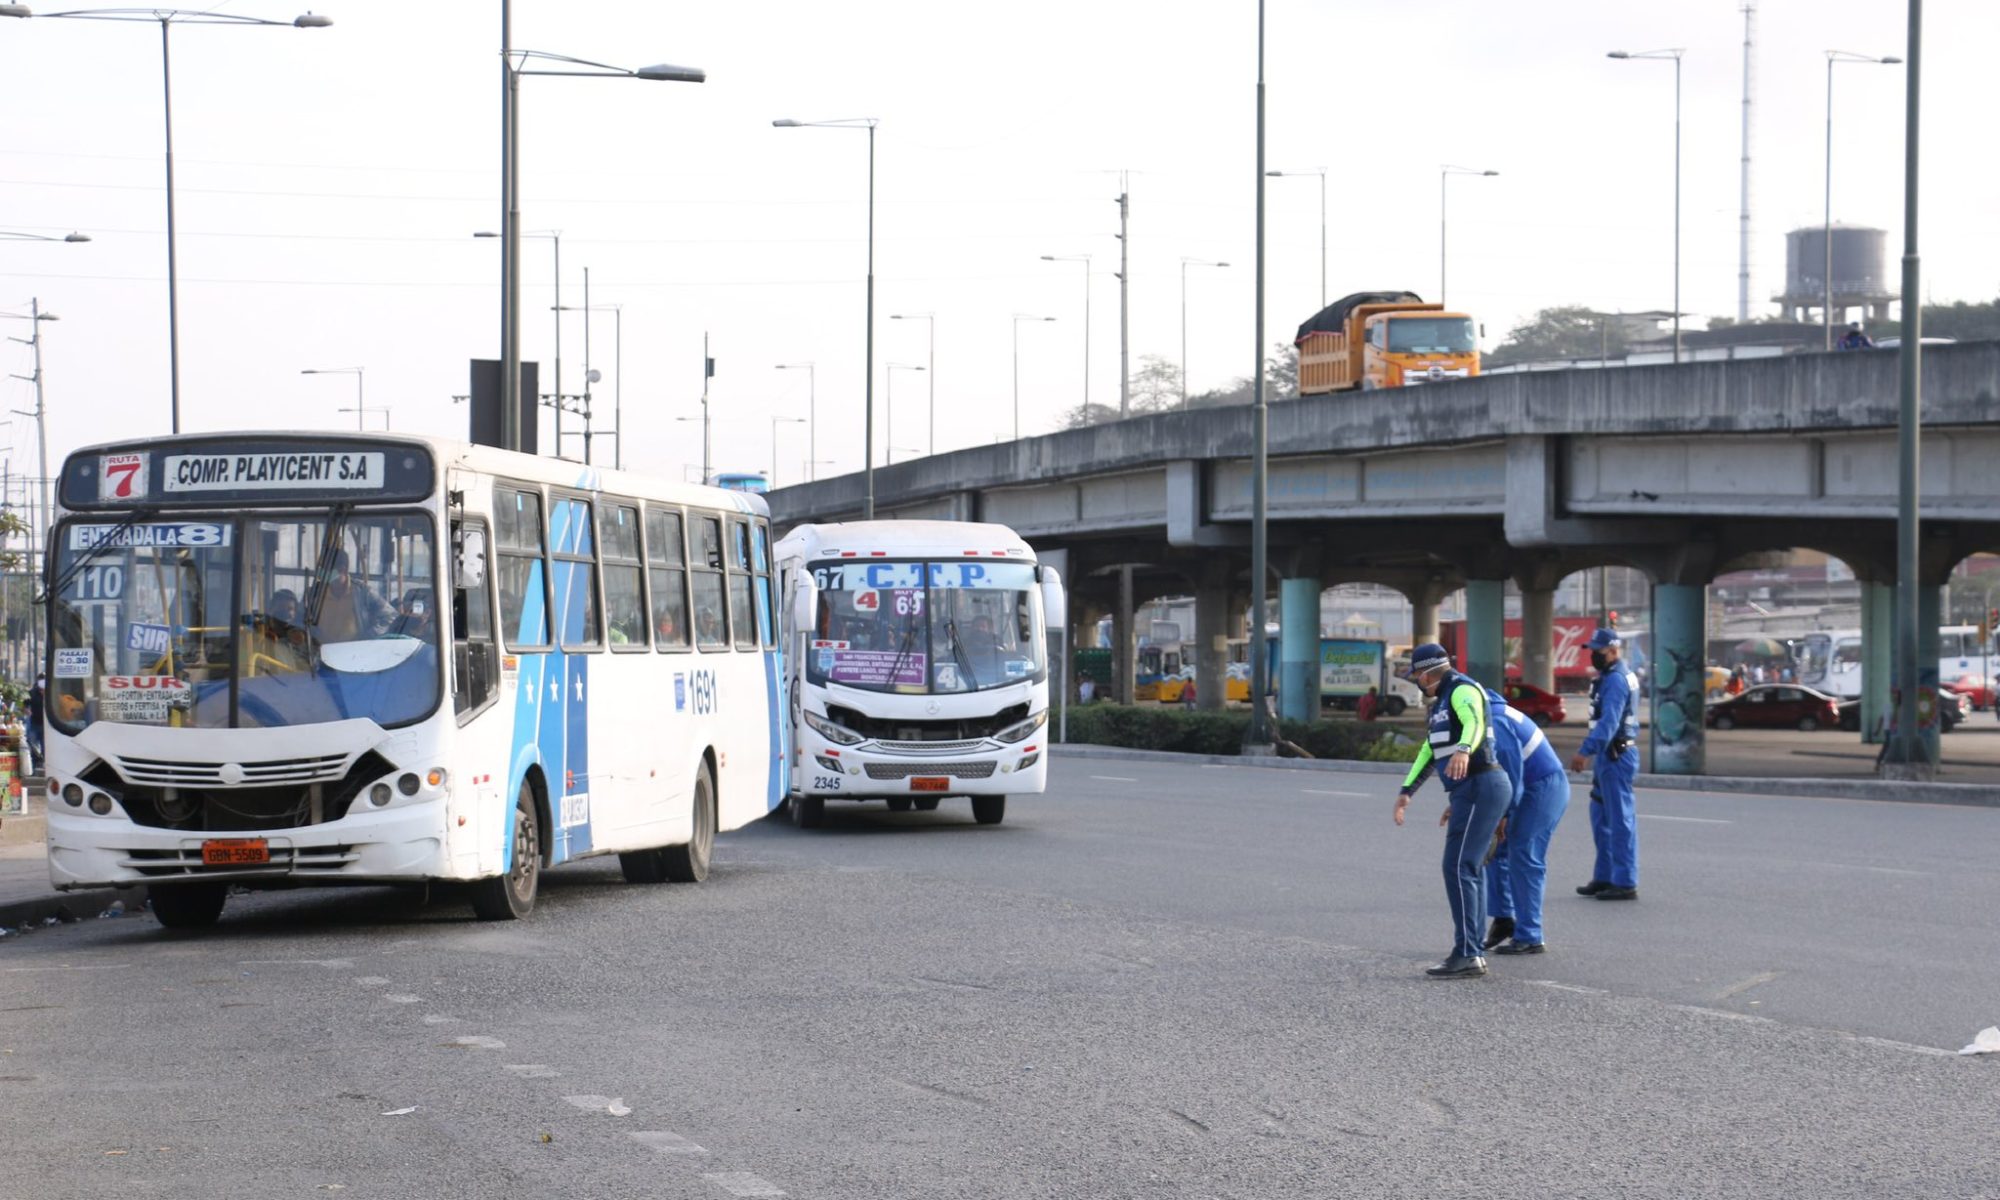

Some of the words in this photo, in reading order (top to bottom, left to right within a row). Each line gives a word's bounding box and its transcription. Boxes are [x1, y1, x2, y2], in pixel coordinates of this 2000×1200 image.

[108, 456, 140, 464] RUTA
[177, 458, 229, 485] COMP.
[234, 456, 335, 482] PLAYICENT
[338, 455, 368, 480] S.A
[106, 463, 141, 497] 7
[79, 526, 154, 548] ENTRADA
[177, 524, 221, 545] 8
[856, 591, 878, 608] 4
[130, 624, 168, 652] SUR
[108, 676, 184, 689] SUR
[937, 665, 959, 689] 4
[689, 669, 718, 715] 1691
[814, 776, 841, 790] 2345
